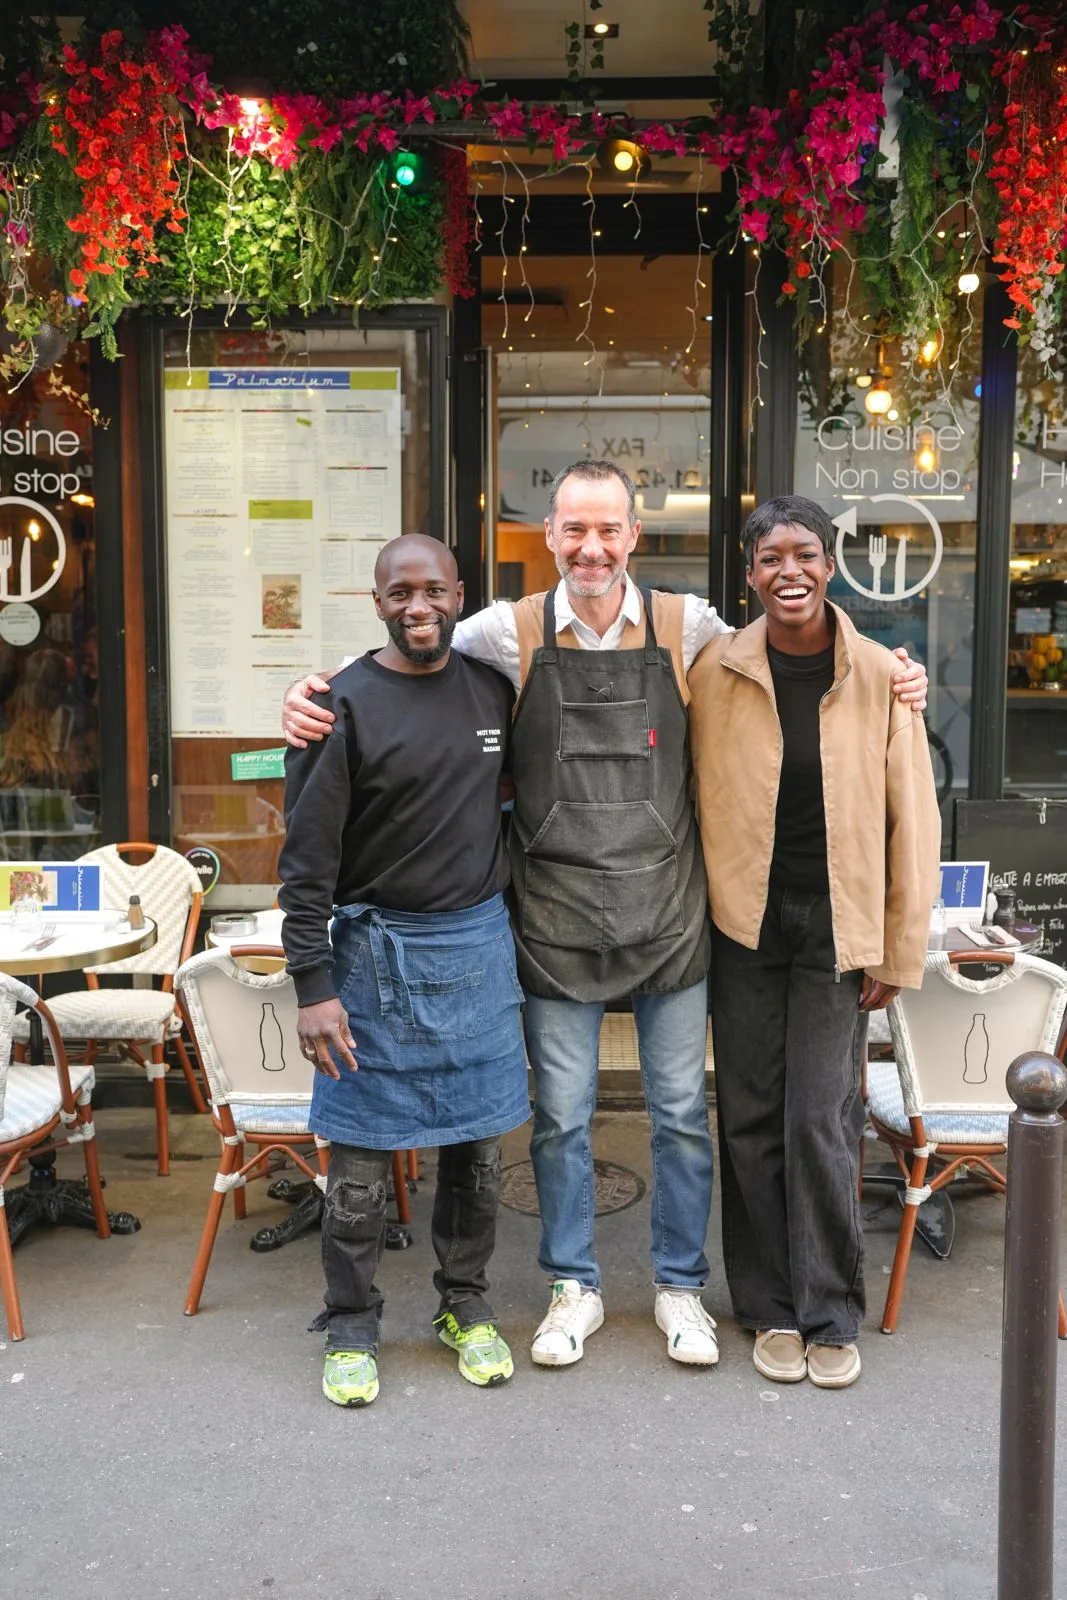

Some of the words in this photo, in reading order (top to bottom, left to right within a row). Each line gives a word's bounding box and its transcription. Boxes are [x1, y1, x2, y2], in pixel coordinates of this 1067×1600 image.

[222, 373, 334, 387] Palmarium
[817, 415, 961, 451] Cuisine
[14, 468, 80, 499] stop
[815, 462, 879, 489] Non
[892, 464, 961, 496] stop
[236, 754, 262, 763] HAPPY
[1022, 871, 1032, 887] A
